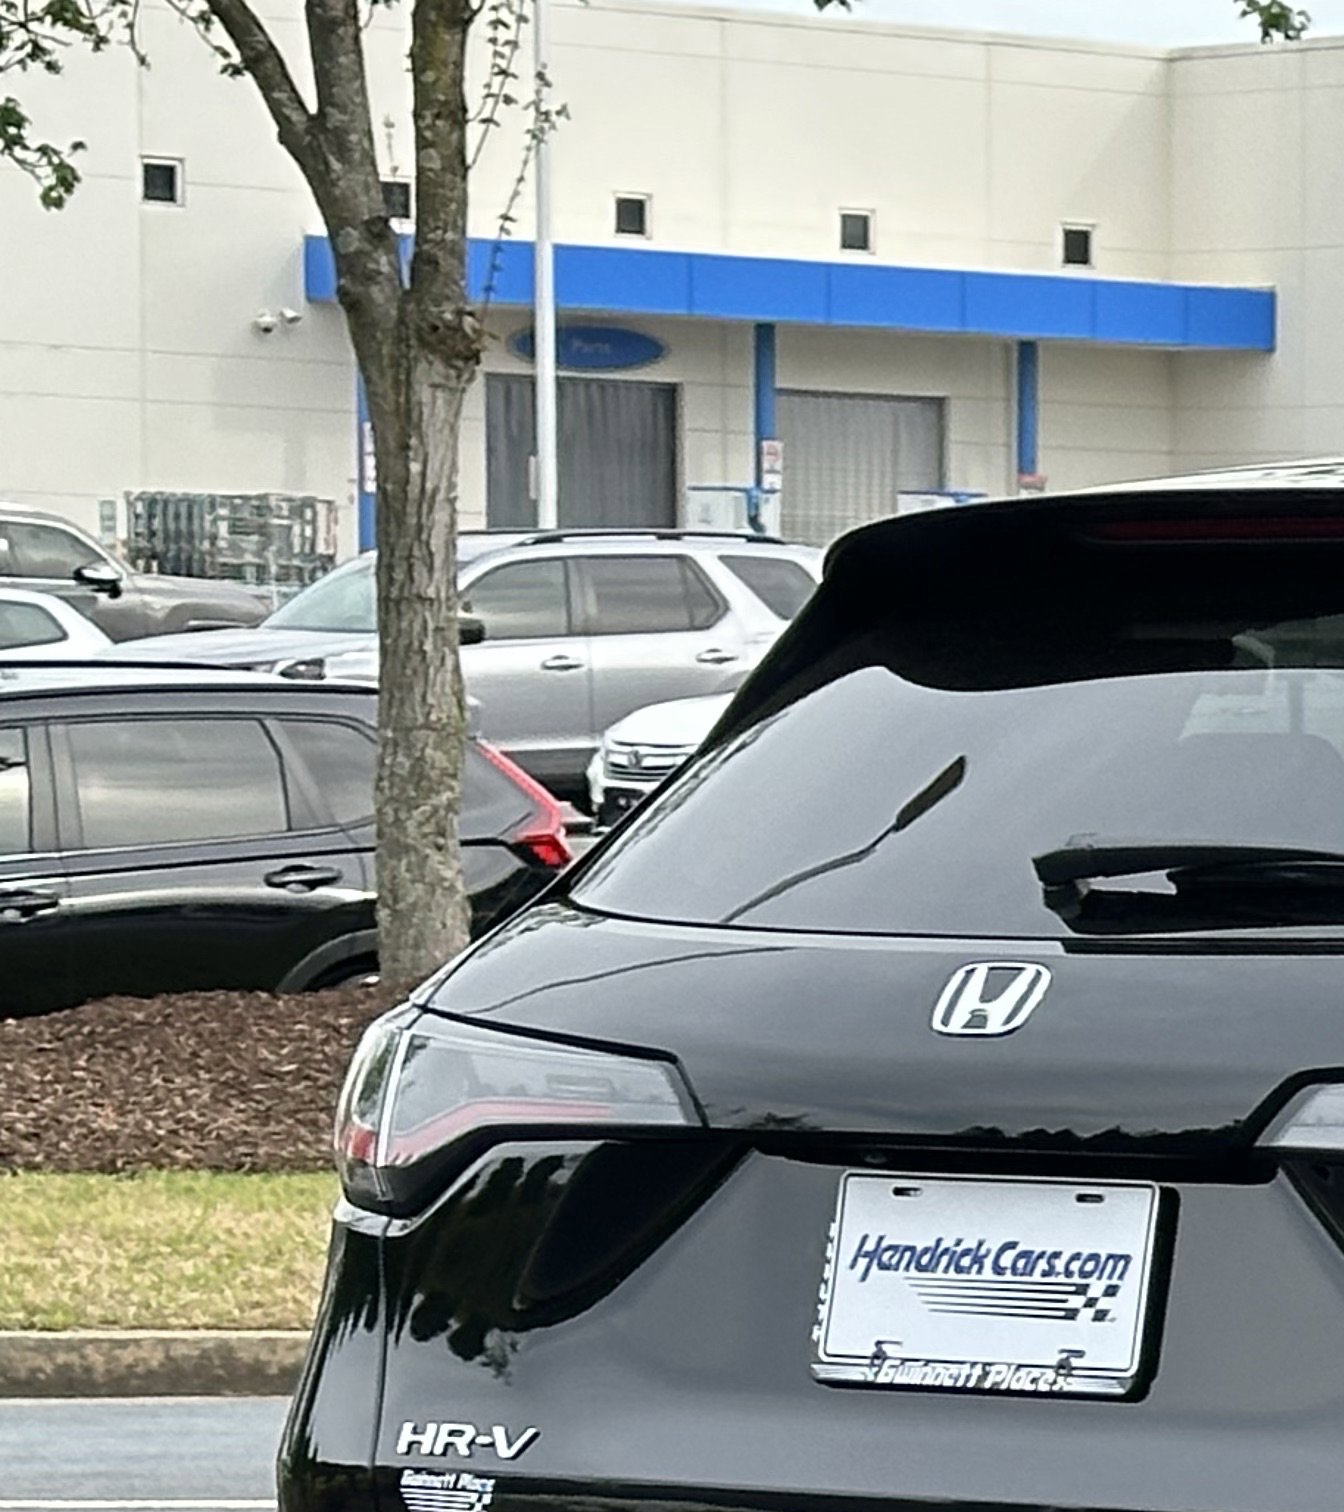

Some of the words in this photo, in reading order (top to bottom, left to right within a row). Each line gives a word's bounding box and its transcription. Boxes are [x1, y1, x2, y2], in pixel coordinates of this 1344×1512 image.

[849, 1233, 1132, 1283] HendrickCars.com
[984, 1364, 1057, 1391] Place
[396, 1422, 540, 1459] HR-V
